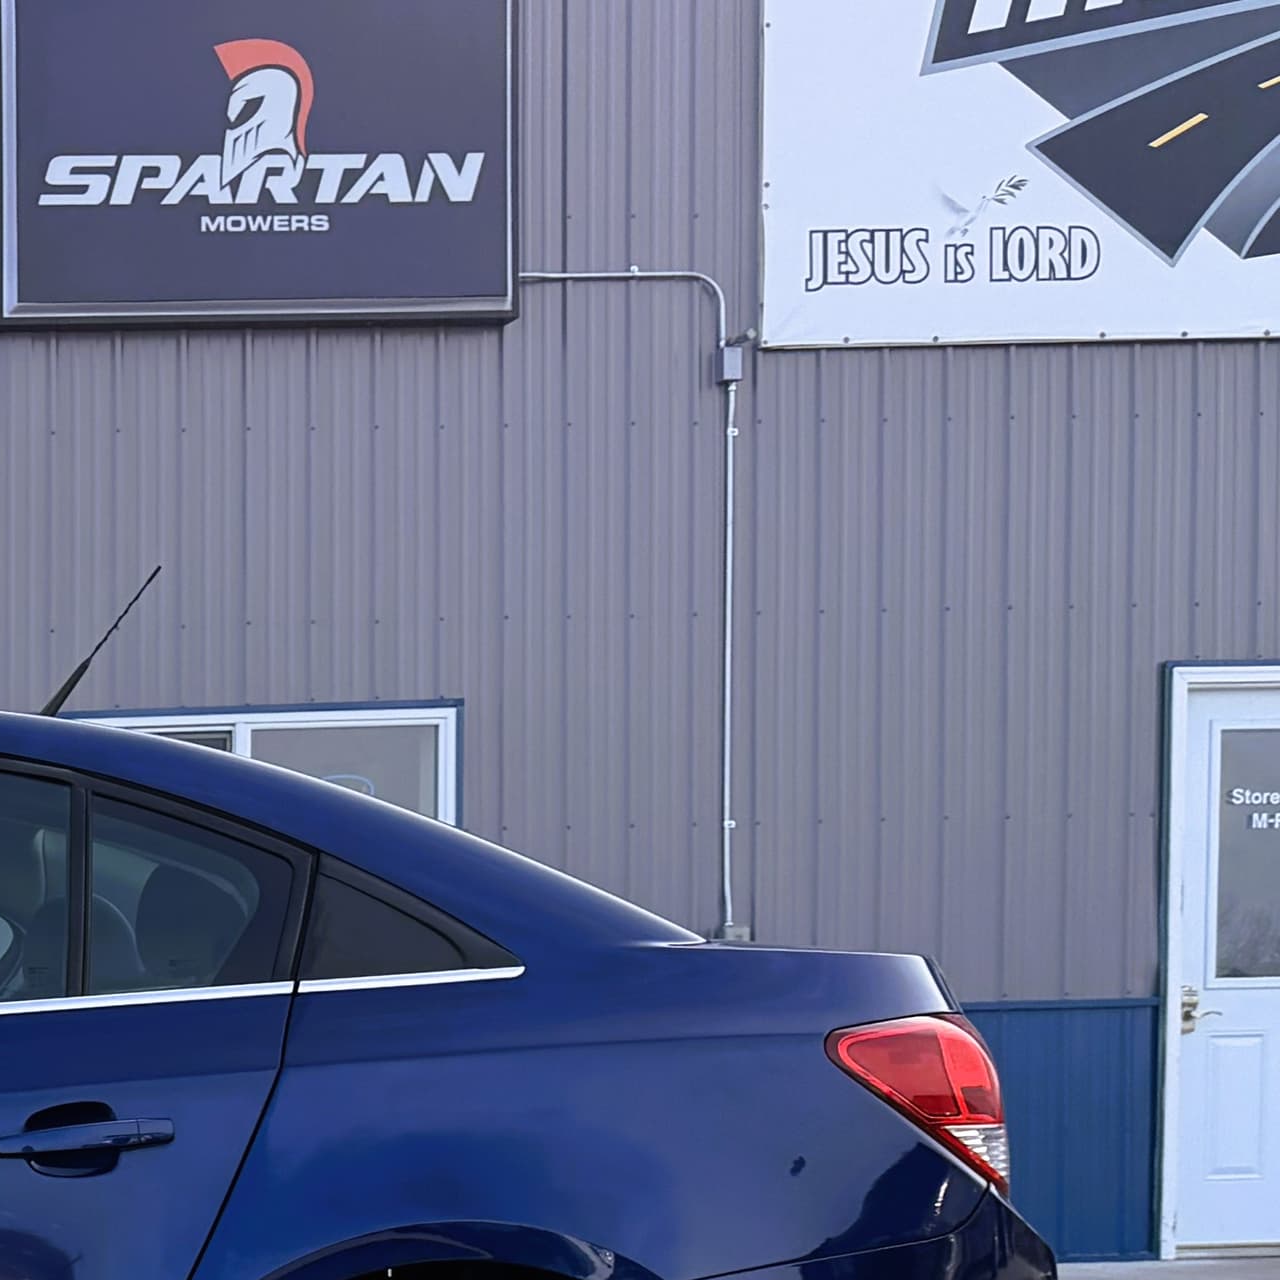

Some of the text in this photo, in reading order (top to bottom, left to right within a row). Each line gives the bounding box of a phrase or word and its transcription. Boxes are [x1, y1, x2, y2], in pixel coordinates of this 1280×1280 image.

[38, 152, 485, 206] SPARTAN
[200, 214, 330, 233] MOWERS
[805, 227, 929, 292] JESUS
[989, 226, 1101, 283] LORD
[1231, 788, 1280, 805] Store
